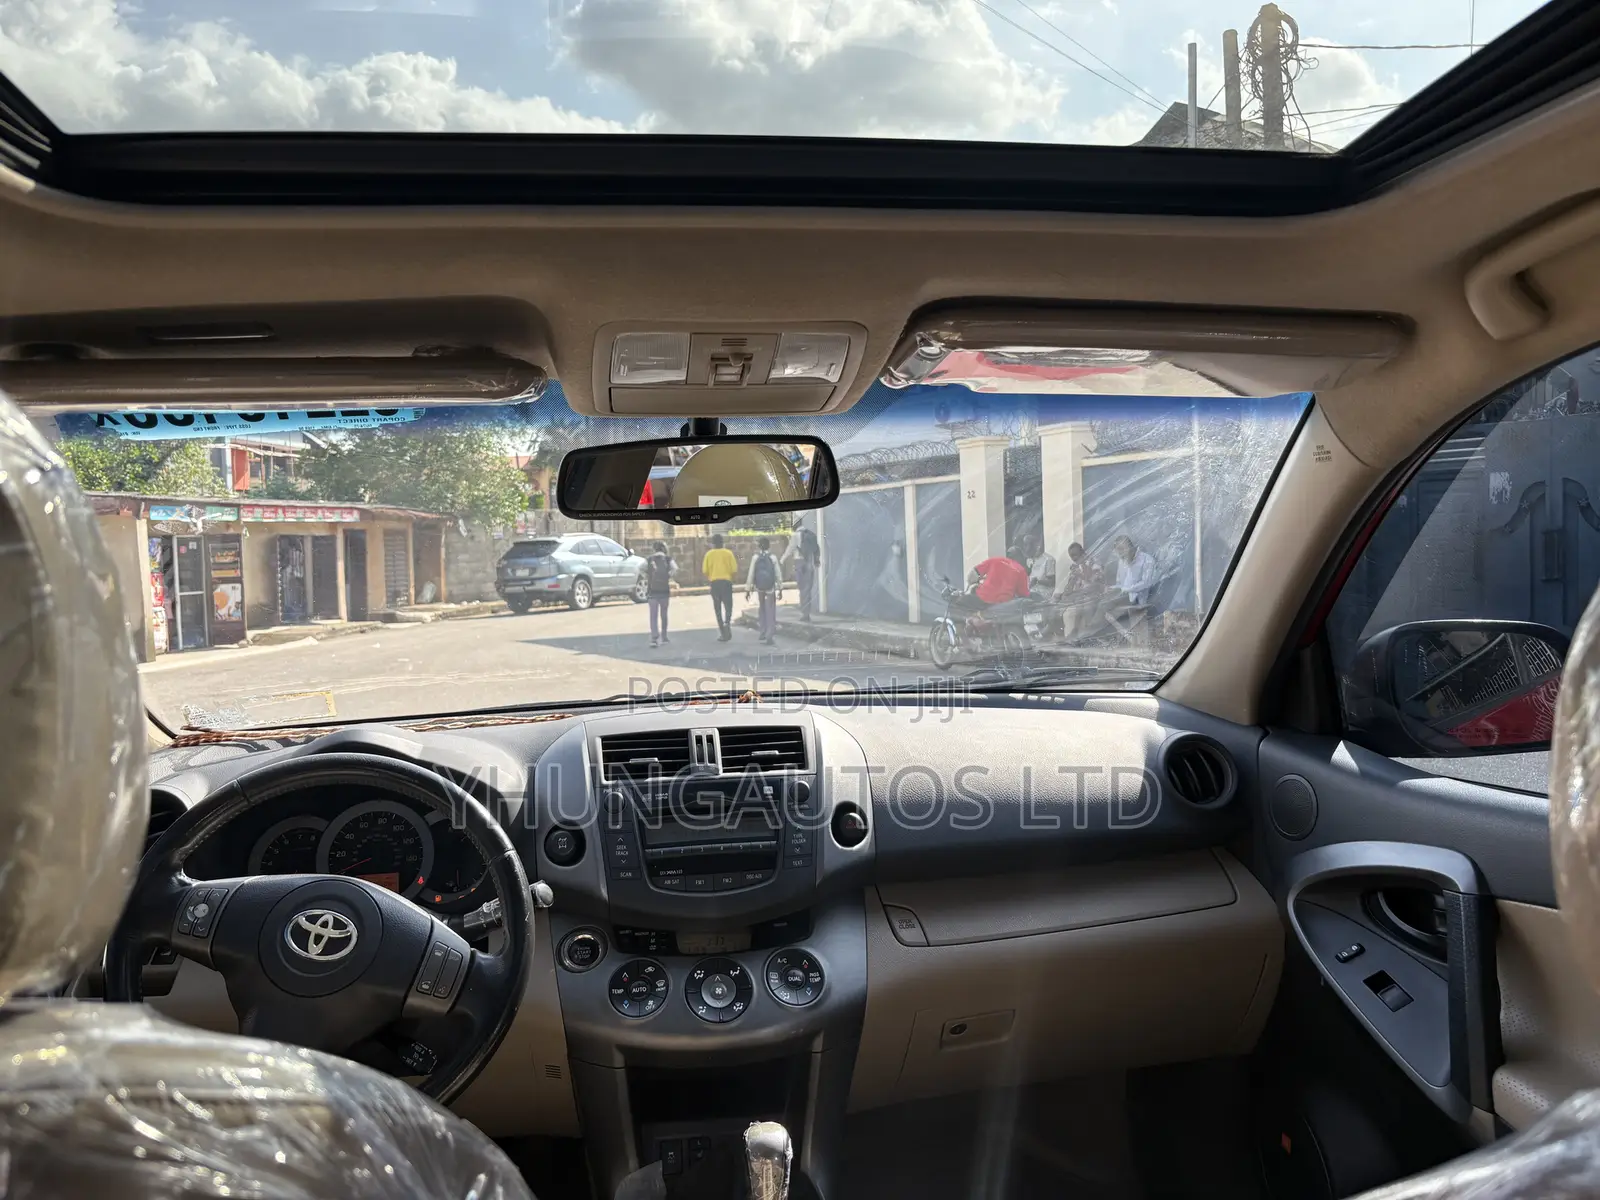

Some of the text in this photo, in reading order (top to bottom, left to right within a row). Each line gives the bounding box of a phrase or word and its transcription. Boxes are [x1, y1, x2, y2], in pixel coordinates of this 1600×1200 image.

[359, 821, 369, 829] 60
[377, 817, 388, 825] 80
[393, 823, 405, 831] 100
[344, 832, 355, 840] 40
[335, 850, 347, 858] 20
